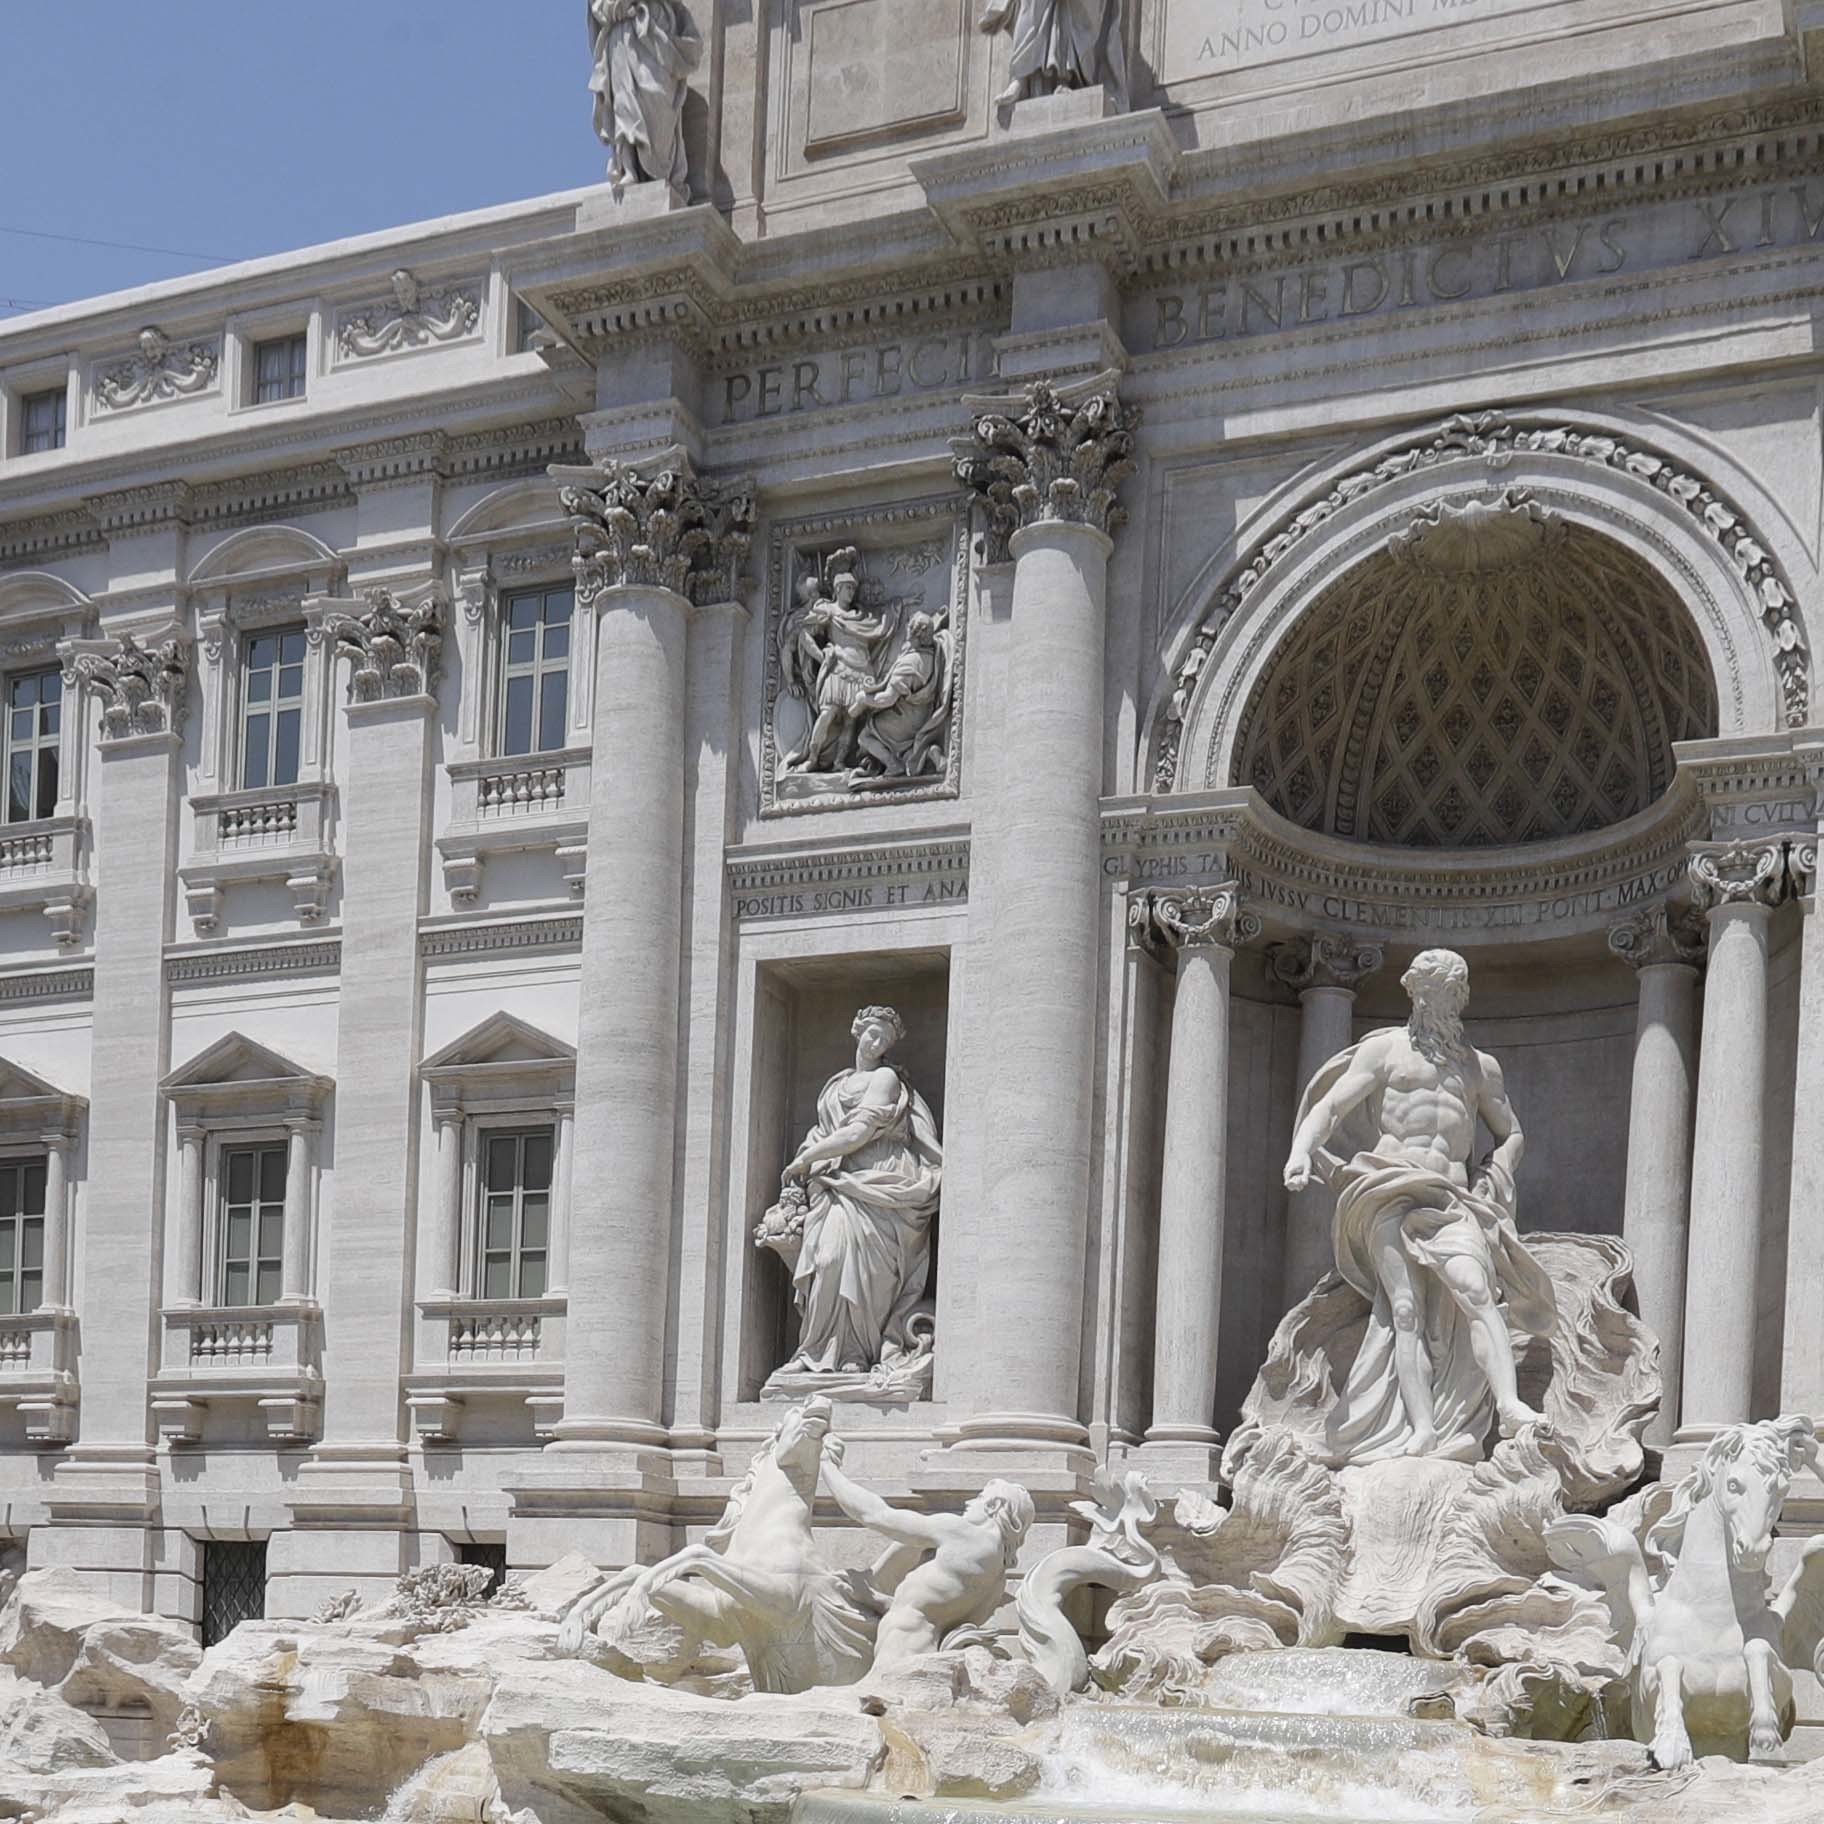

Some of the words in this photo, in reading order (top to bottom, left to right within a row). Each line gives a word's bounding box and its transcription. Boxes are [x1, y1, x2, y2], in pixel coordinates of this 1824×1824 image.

[1197, 20, 1287, 60] ANNO
[1152, 216, 1628, 350] BENEDICTVS
[735, 894, 804, 918] POSITIS
[814, 888, 873, 912] SIGNIS
[887, 885, 910, 905] ET
